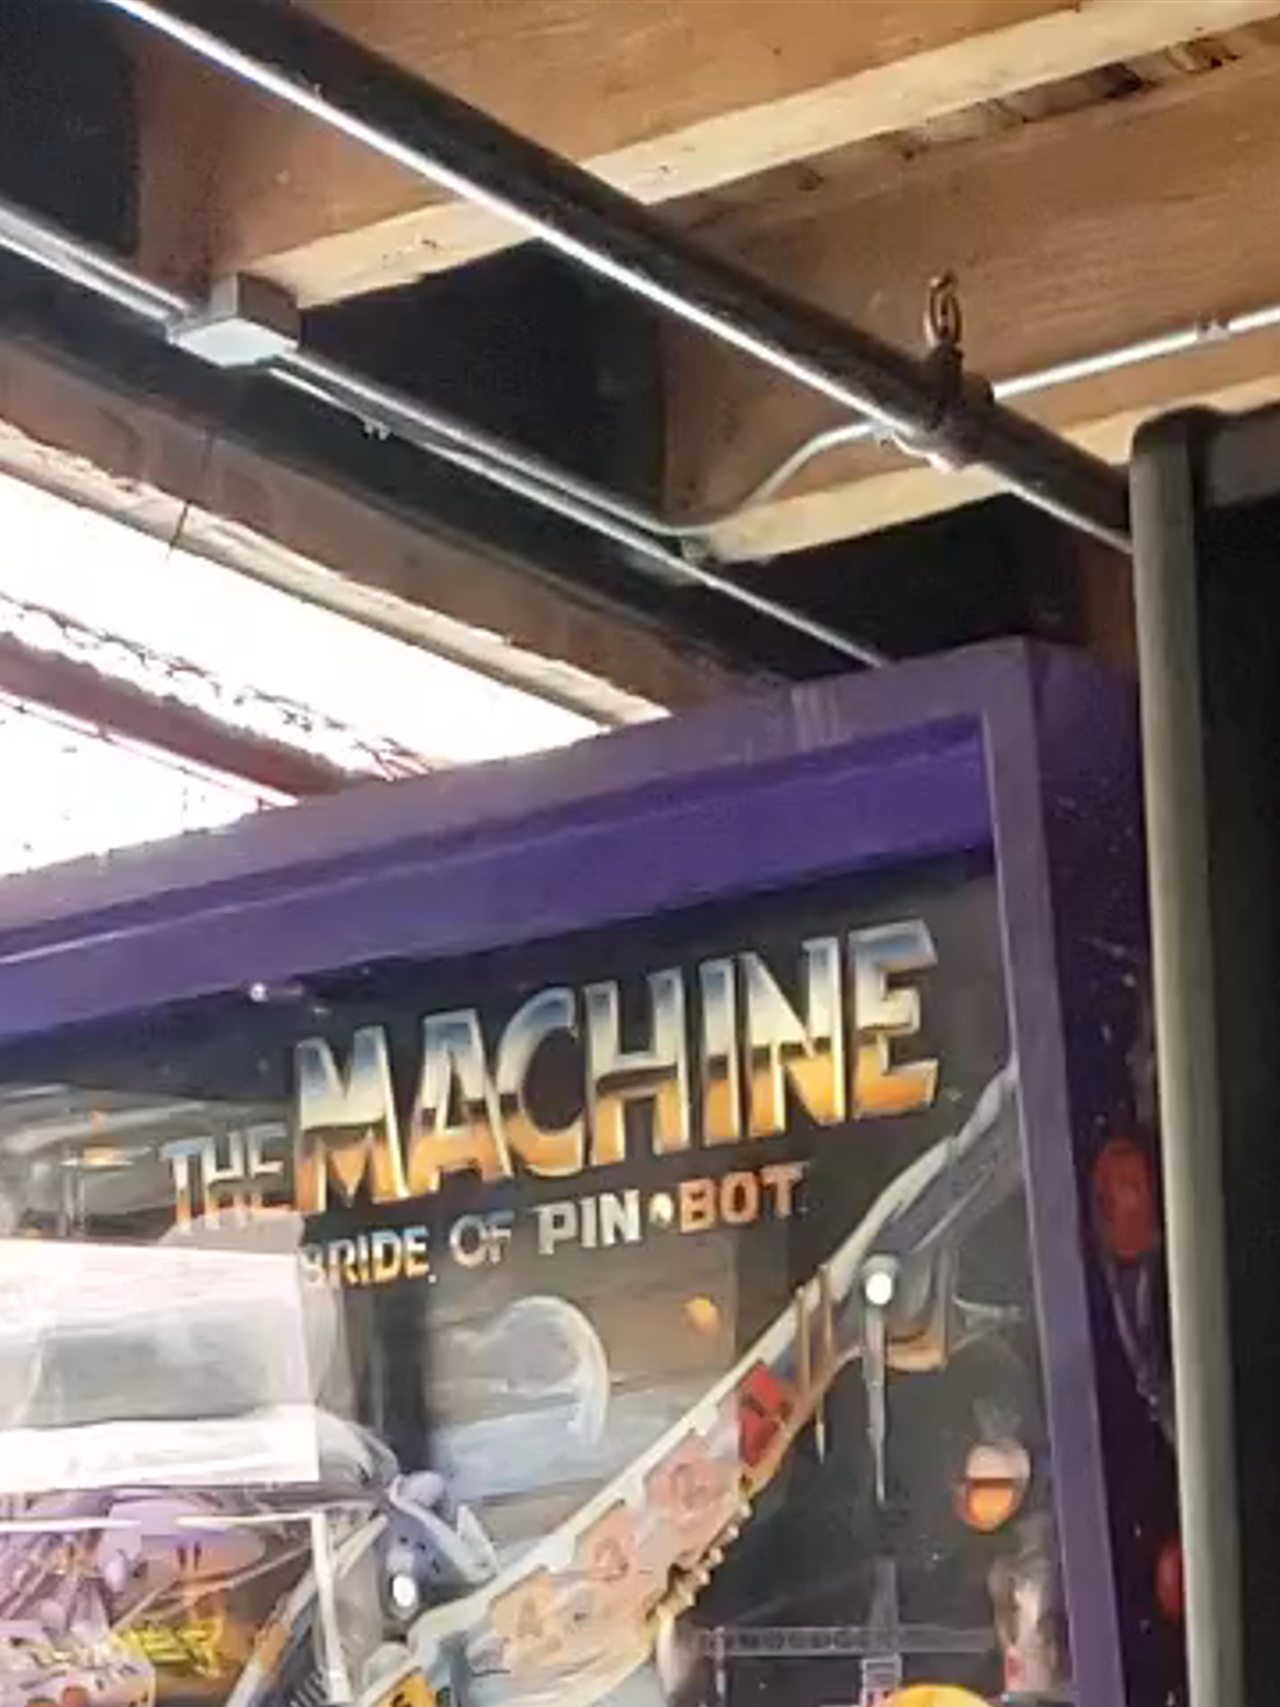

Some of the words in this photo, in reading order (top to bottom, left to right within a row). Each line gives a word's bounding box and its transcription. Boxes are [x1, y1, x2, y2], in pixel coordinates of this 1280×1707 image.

[159, 1123, 290, 1231] THE
[293, 920, 940, 1216] MACHINE
[300, 1222, 433, 1289] BRIDE
[451, 1208, 513, 1268] OF
